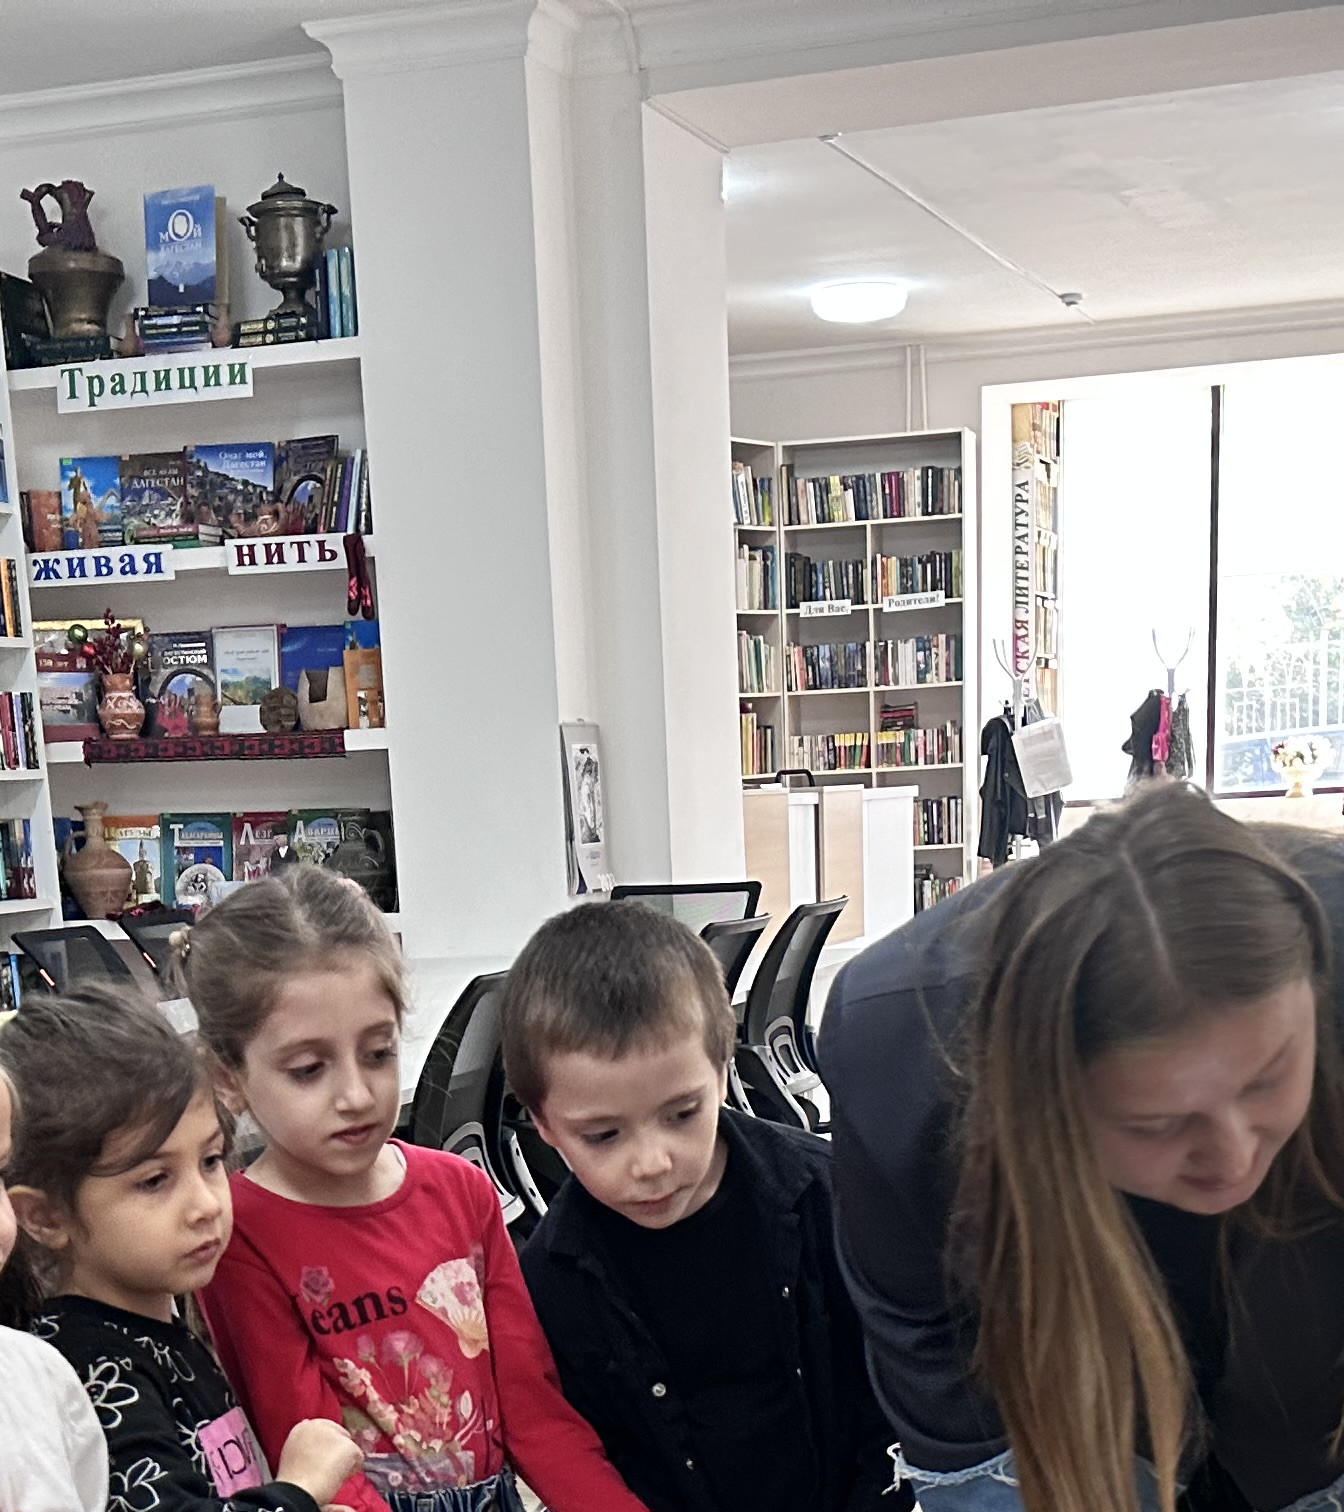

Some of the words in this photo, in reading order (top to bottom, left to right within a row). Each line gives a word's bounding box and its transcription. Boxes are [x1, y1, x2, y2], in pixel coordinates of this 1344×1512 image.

[60, 361, 249, 407] Традиции
[234, 539, 339, 568] нить
[1014, 479, 1031, 615] ЛИТЕРАТУРА
[32, 550, 165, 582] живая
[162, 655, 208, 665] ОСТЮМ
